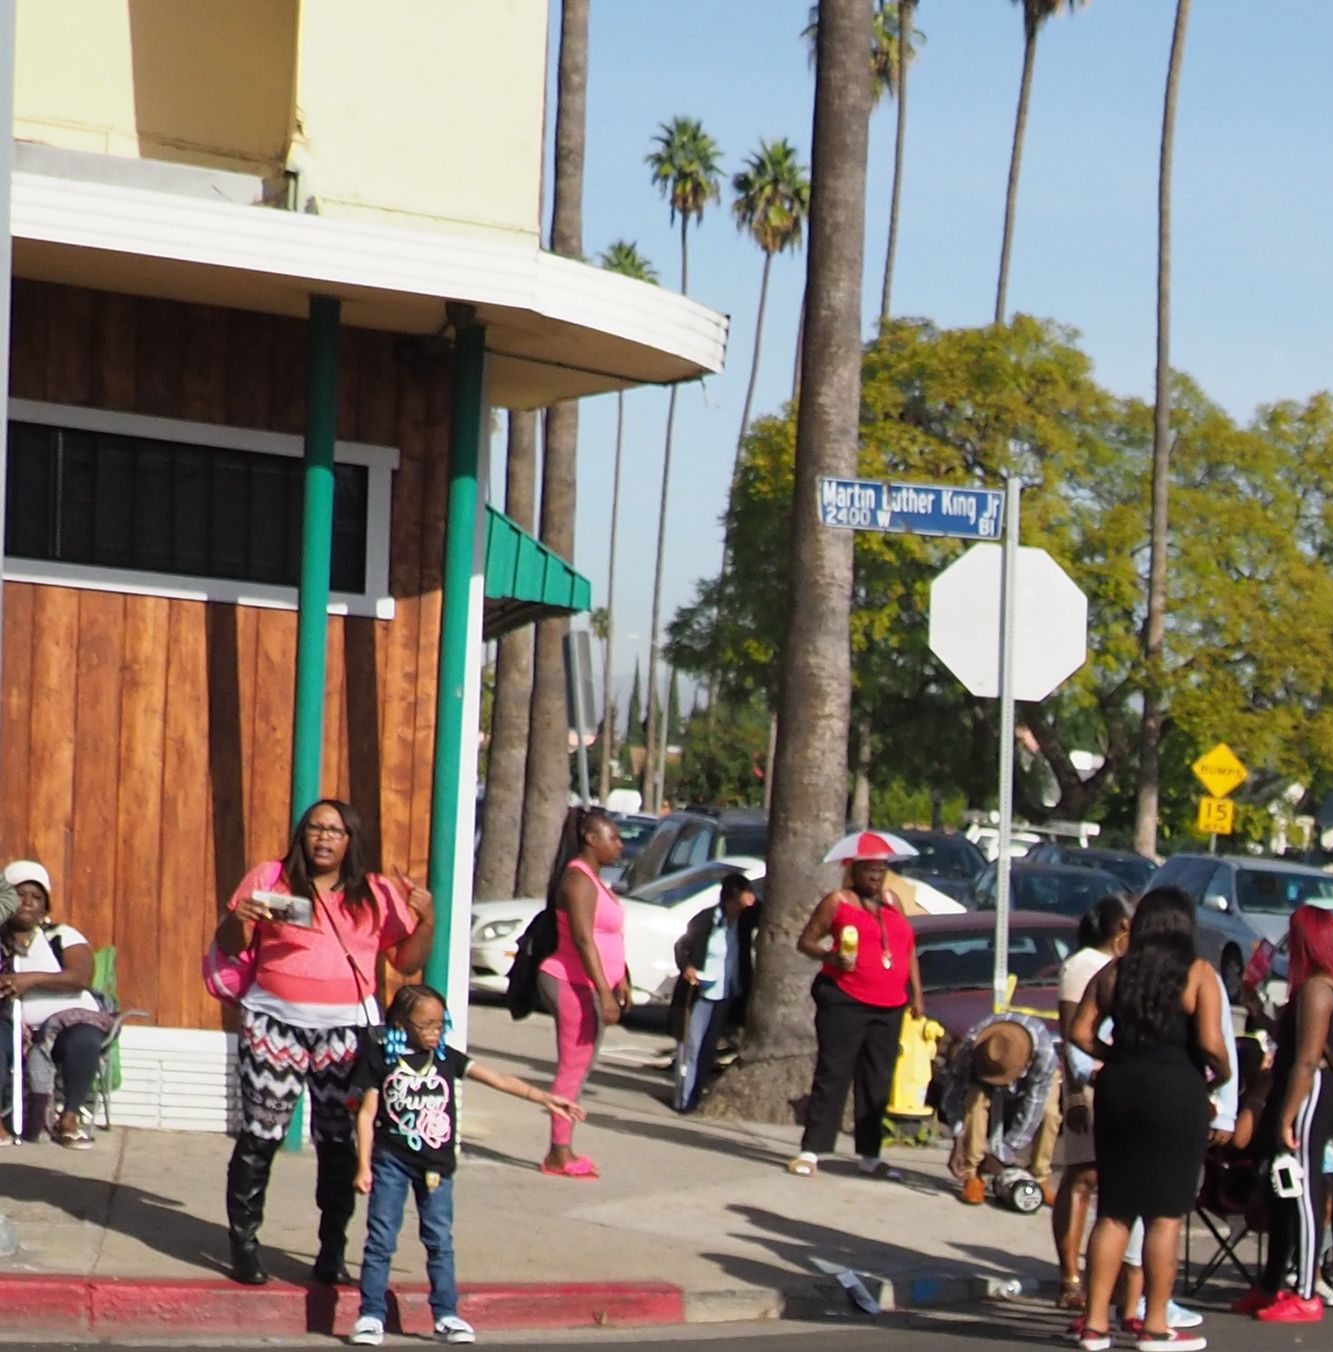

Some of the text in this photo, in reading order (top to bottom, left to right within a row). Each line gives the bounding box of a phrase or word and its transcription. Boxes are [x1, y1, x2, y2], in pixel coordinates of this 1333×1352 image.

[823, 480, 1000, 526] Martin Luther King Jr
[825, 507, 891, 528] 2400 W
[1207, 803, 1227, 822] 15
